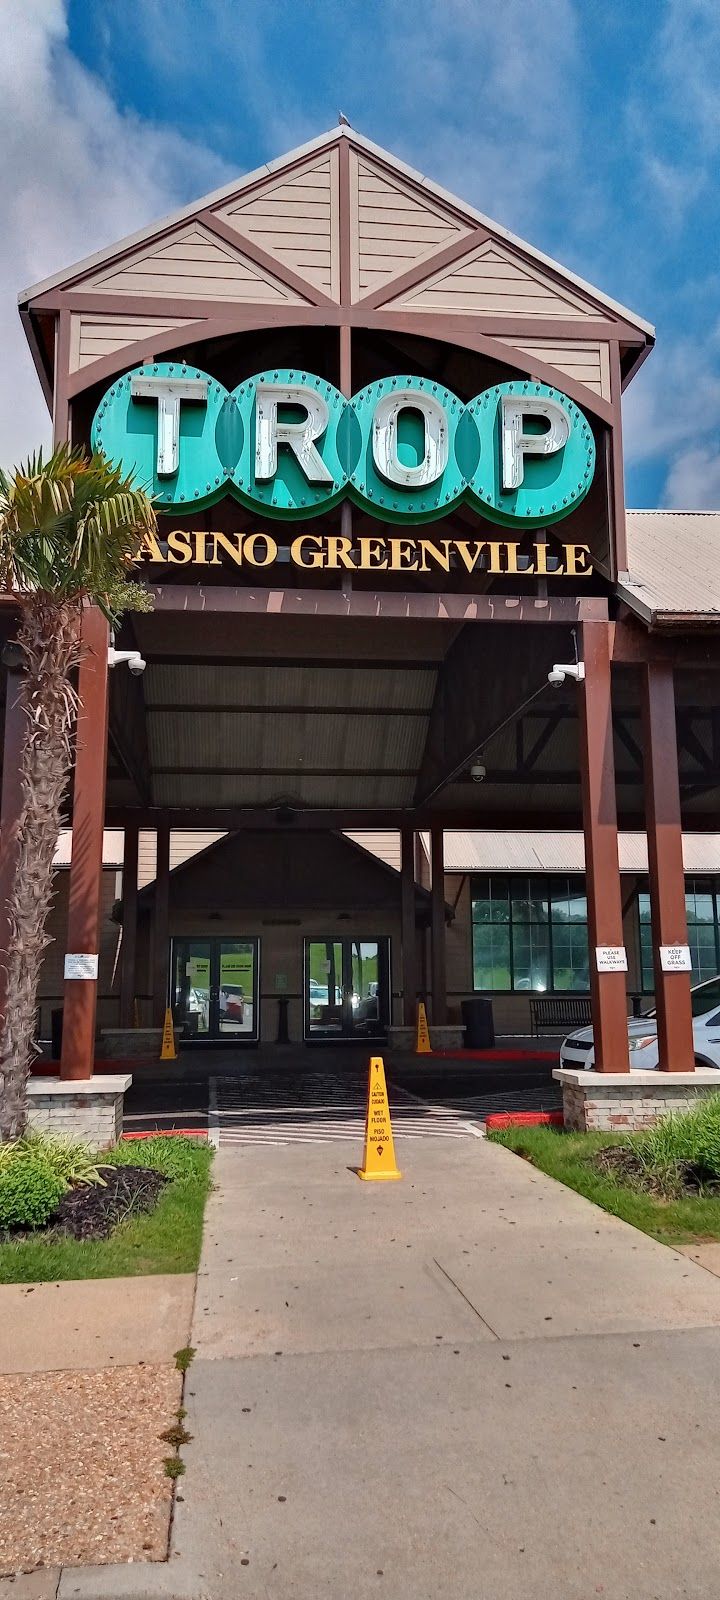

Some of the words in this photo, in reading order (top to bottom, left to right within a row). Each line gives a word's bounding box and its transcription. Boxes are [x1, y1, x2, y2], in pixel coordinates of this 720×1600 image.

[130, 375, 571, 493] TROP
[130, 530, 277, 567] ASINO
[290, 535, 594, 576] GREENVILLE
